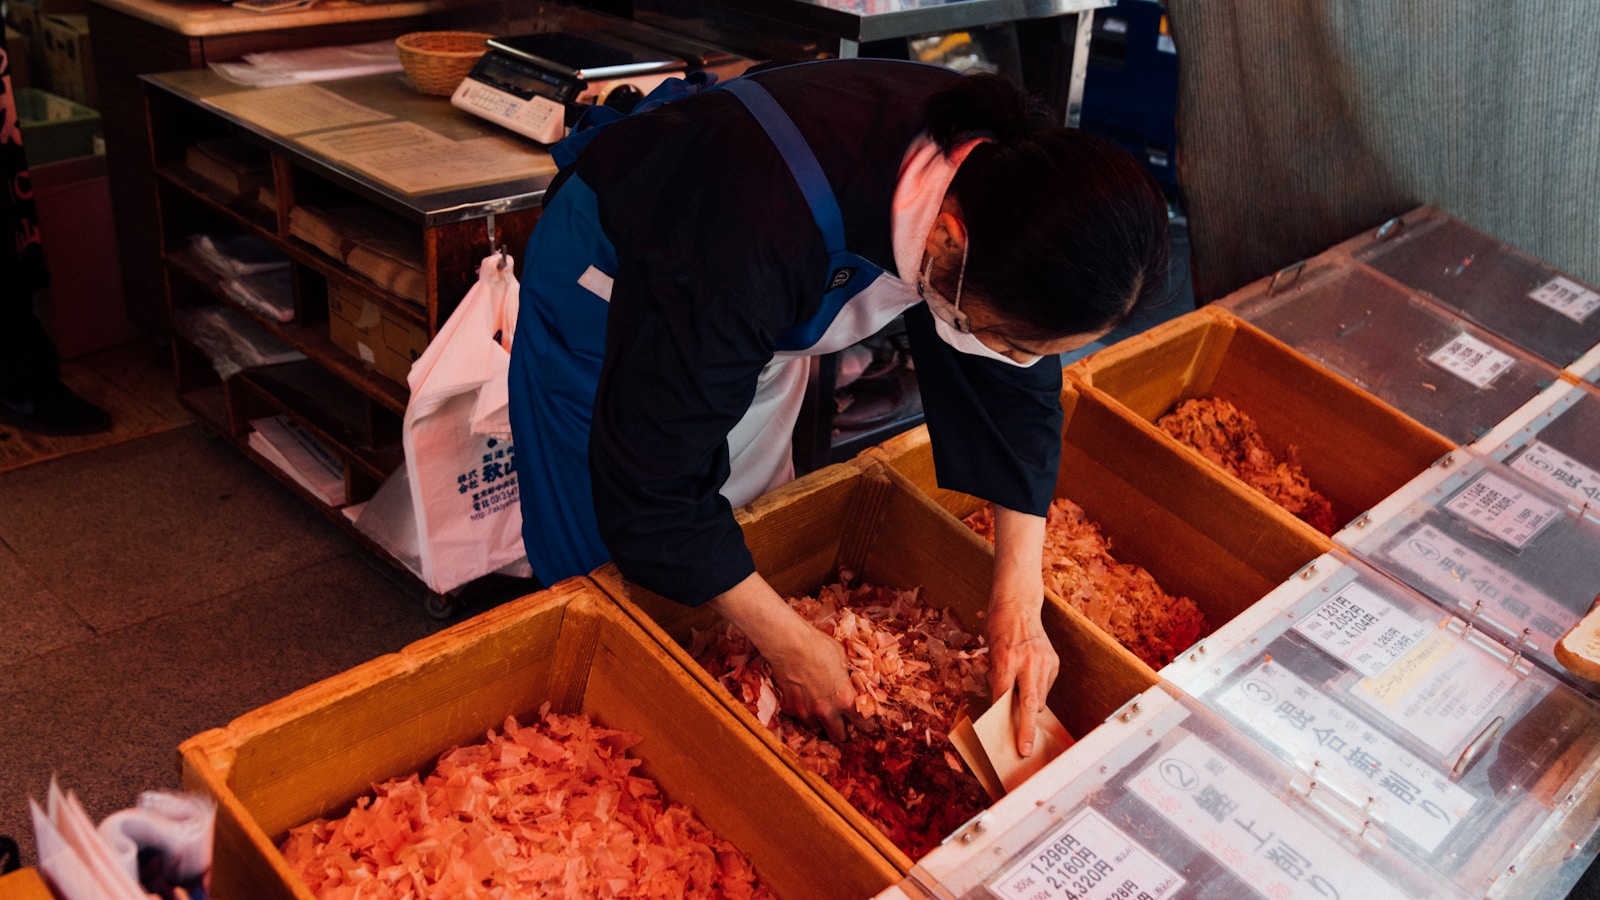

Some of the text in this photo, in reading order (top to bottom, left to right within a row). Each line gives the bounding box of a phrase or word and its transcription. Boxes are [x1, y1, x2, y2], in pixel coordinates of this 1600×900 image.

[1317, 596, 1351, 621] 1,231円
[1330, 605, 1365, 630] 2,052円
[1345, 613, 1379, 639] 4,104円
[1013, 834, 1081, 894] 300g 1,296円
[1046, 847, 1098, 890] 2,160円
[1065, 859, 1114, 900] 4,320円
